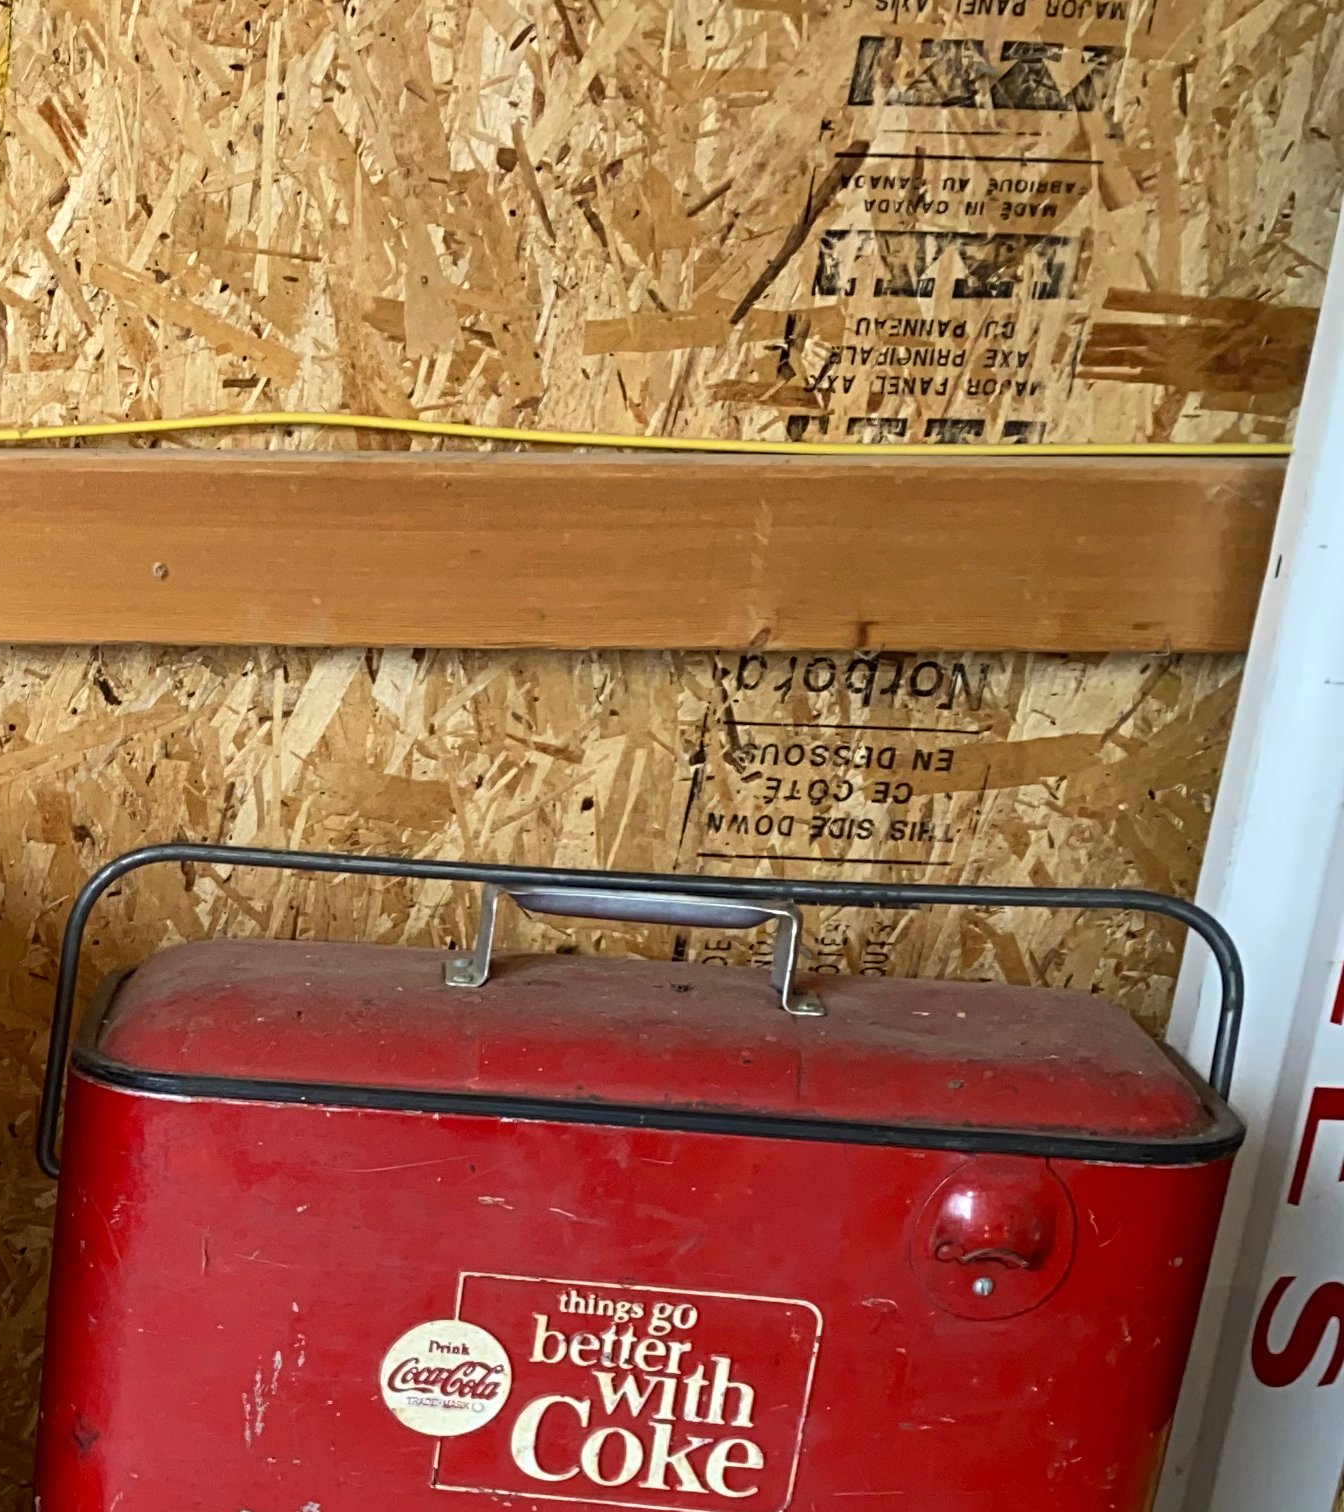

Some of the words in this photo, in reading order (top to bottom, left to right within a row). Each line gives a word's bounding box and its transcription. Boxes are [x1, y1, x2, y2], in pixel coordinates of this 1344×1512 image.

[839, 174, 925, 192] CANADA
[942, 177, 971, 193] AU
[863, 198, 949, 215] CANADA
[965, 201, 985, 215] IN
[856, 317, 967, 336] PANNEAU
[984, 318, 1016, 336] DU
[828, 345, 966, 366] PRINCIPALE
[984, 349, 1030, 367] AXE
[870, 376, 948, 395] PANEL
[740, 743, 896, 770] DESSOUS
[912, 749, 954, 772] EN
[763, 777, 854, 805] CÔTÉ
[872, 782, 913, 804] CE
[706, 812, 794, 836] DOWN
[809, 816, 874, 841] SIDE
[890, 820, 955, 842] THIS
[559, 1290, 645, 1323] things
[647, 1302, 698, 1336] go
[429, 1340, 470, 1355] Drink
[530, 1314, 691, 1374] better
[387, 1358, 504, 1401] Coca-Cola
[592, 1355, 755, 1427] with
[511, 1394, 765, 1499] Coke
